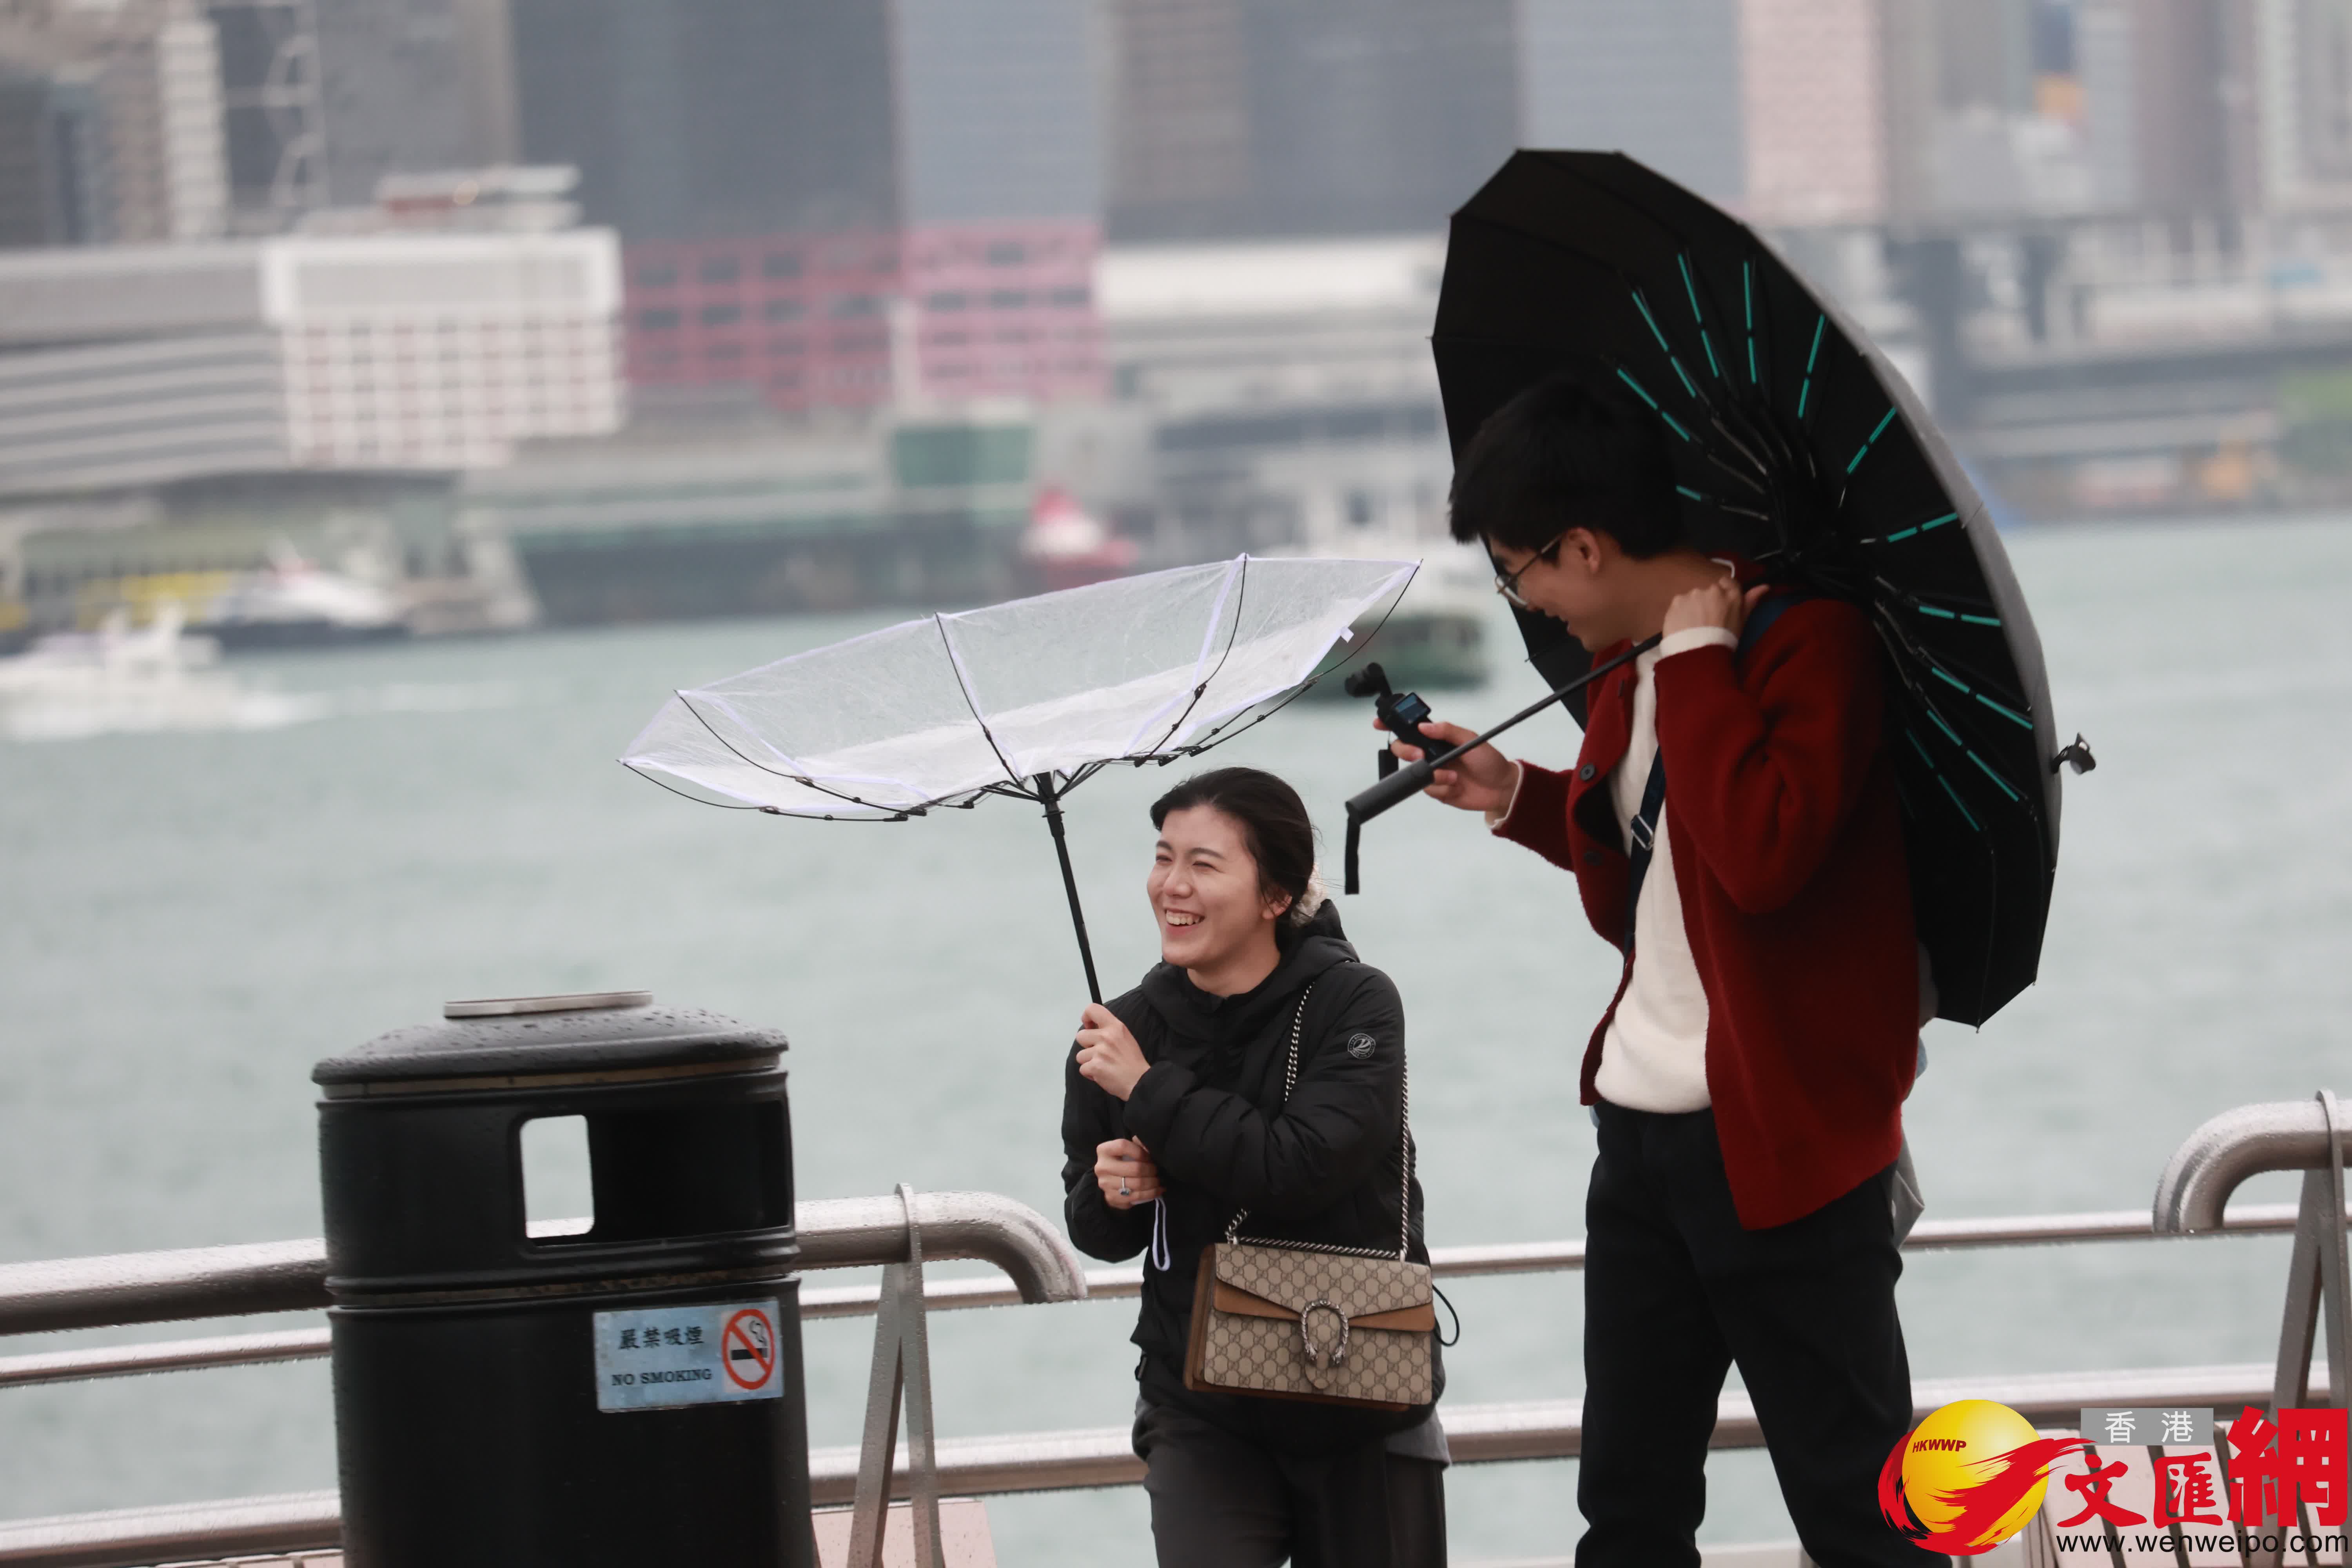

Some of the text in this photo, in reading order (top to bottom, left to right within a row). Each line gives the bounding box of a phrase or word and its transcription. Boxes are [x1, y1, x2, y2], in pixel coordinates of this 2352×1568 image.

[619, 1326, 704, 1349] 嚴禁吸煙
[612, 1368, 712, 1386] NO SMOKING
